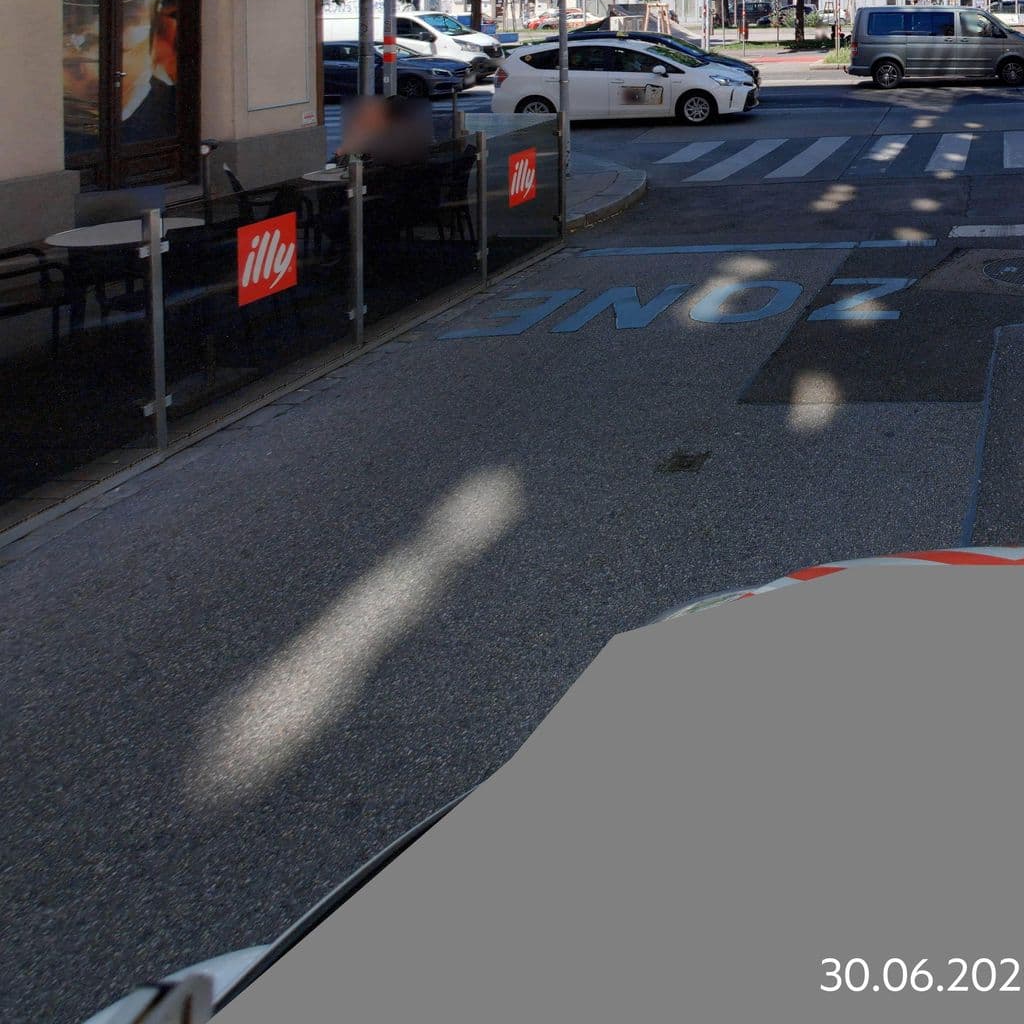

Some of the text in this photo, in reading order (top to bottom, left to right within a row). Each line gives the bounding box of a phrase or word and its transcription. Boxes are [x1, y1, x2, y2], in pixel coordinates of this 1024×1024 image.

[511, 158, 536, 199] illy
[242, 229, 295, 289] illy
[436, 278, 917, 340] ZONE
